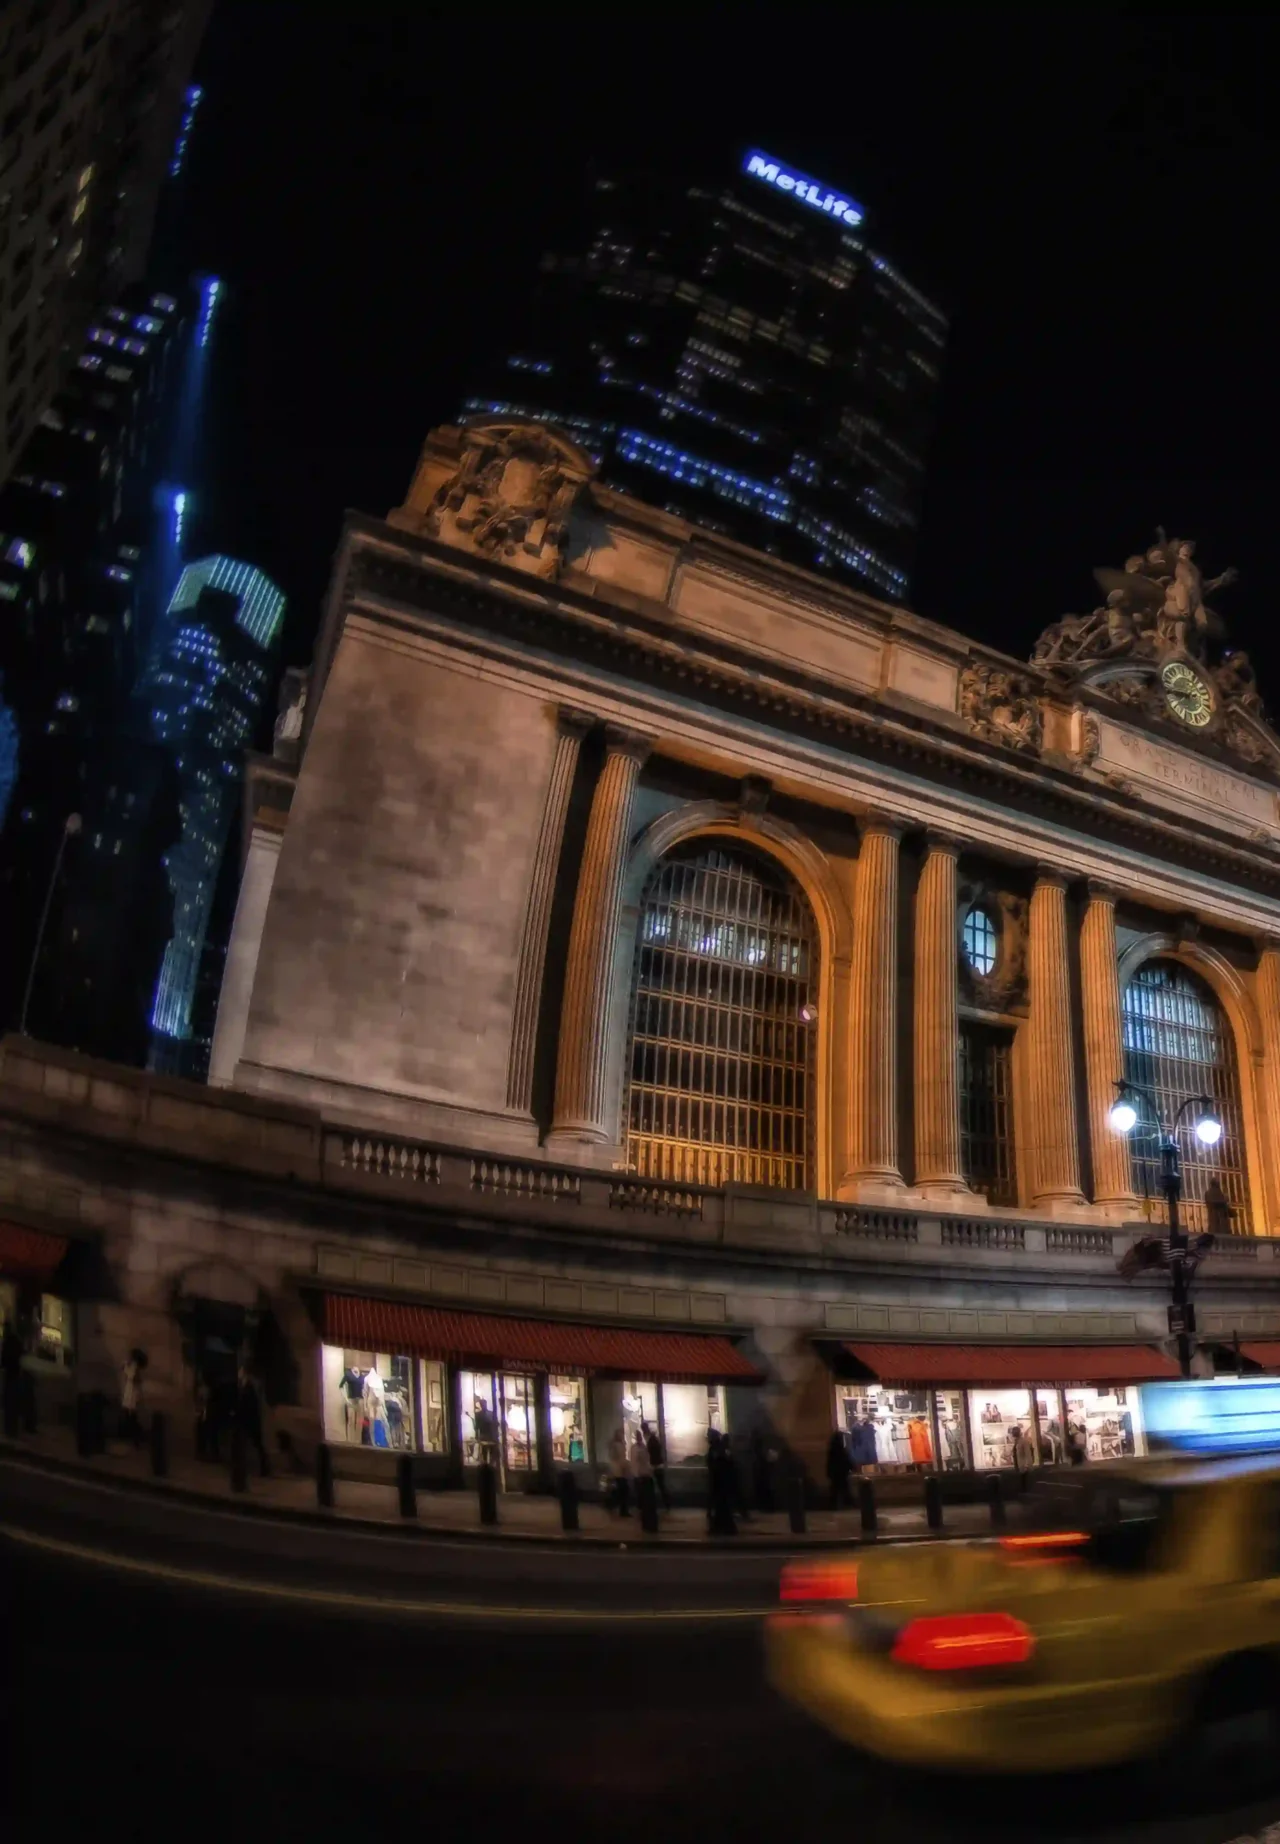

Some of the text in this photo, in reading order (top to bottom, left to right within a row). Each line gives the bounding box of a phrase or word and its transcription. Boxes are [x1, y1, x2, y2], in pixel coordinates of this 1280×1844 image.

[747, 155, 863, 226] MetLife
[1120, 733, 1259, 801] GRAND CENTRAL
[1154, 761, 1231, 802] TERMINAL
